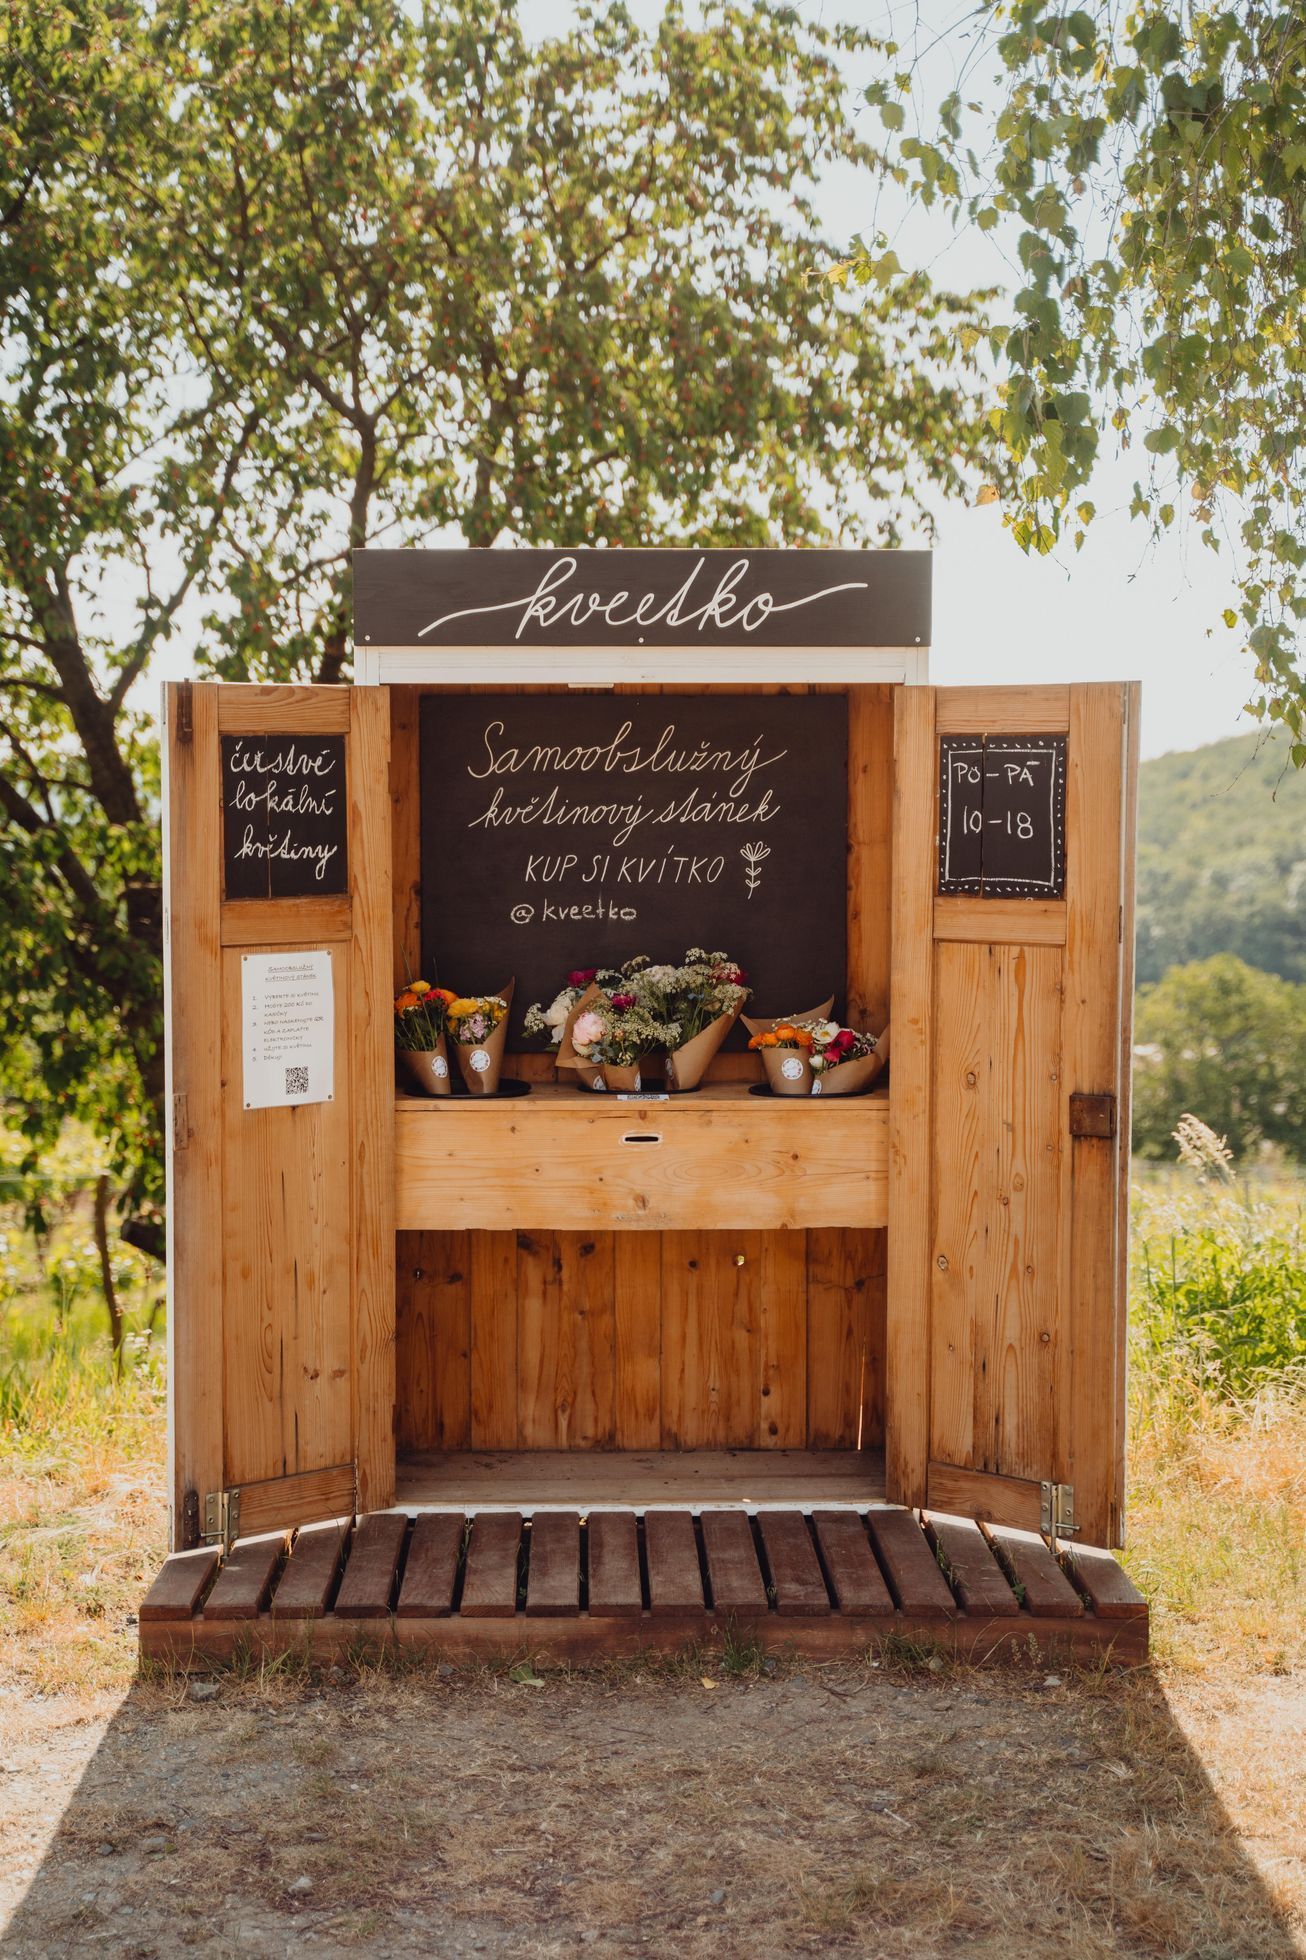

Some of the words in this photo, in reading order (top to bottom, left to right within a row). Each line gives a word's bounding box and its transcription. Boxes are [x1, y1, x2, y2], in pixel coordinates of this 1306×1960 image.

[418, 556, 869, 640] kveetko
[230, 741, 336, 776] čerstvé
[467, 720, 789, 798] Samoobslužný
[229, 780, 337, 816] lokální
[467, 786, 654, 847] květinový
[651, 786, 781, 824] stánek
[234, 823, 338, 881] květiny
[525, 854, 578, 883] KUP
[581, 854, 610, 883] SI
[617, 844, 726, 884] KVÍTKO
